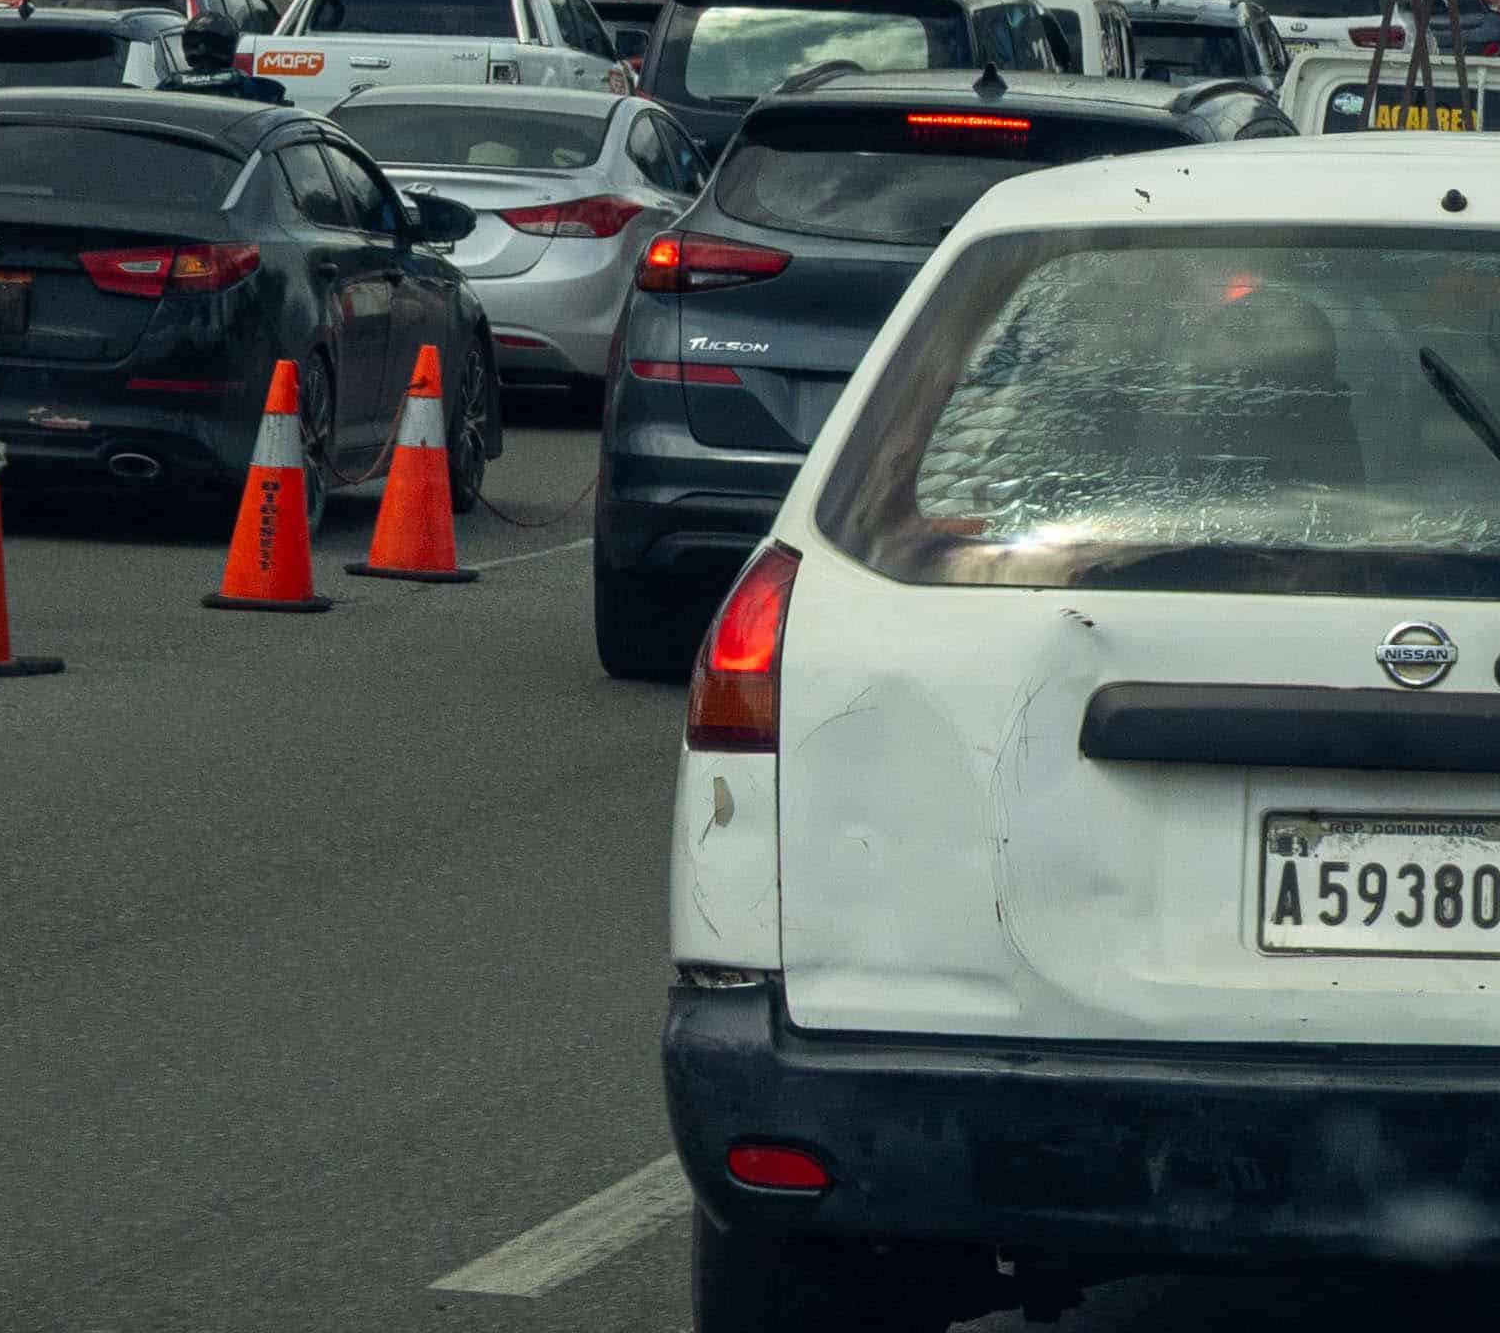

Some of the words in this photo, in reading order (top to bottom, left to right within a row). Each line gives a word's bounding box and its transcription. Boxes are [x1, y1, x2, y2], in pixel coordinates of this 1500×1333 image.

[264, 54, 322, 70] MOPC
[1384, 648, 1449, 661] NISSAN
[1375, 823, 1486, 836] DOMINICANA
